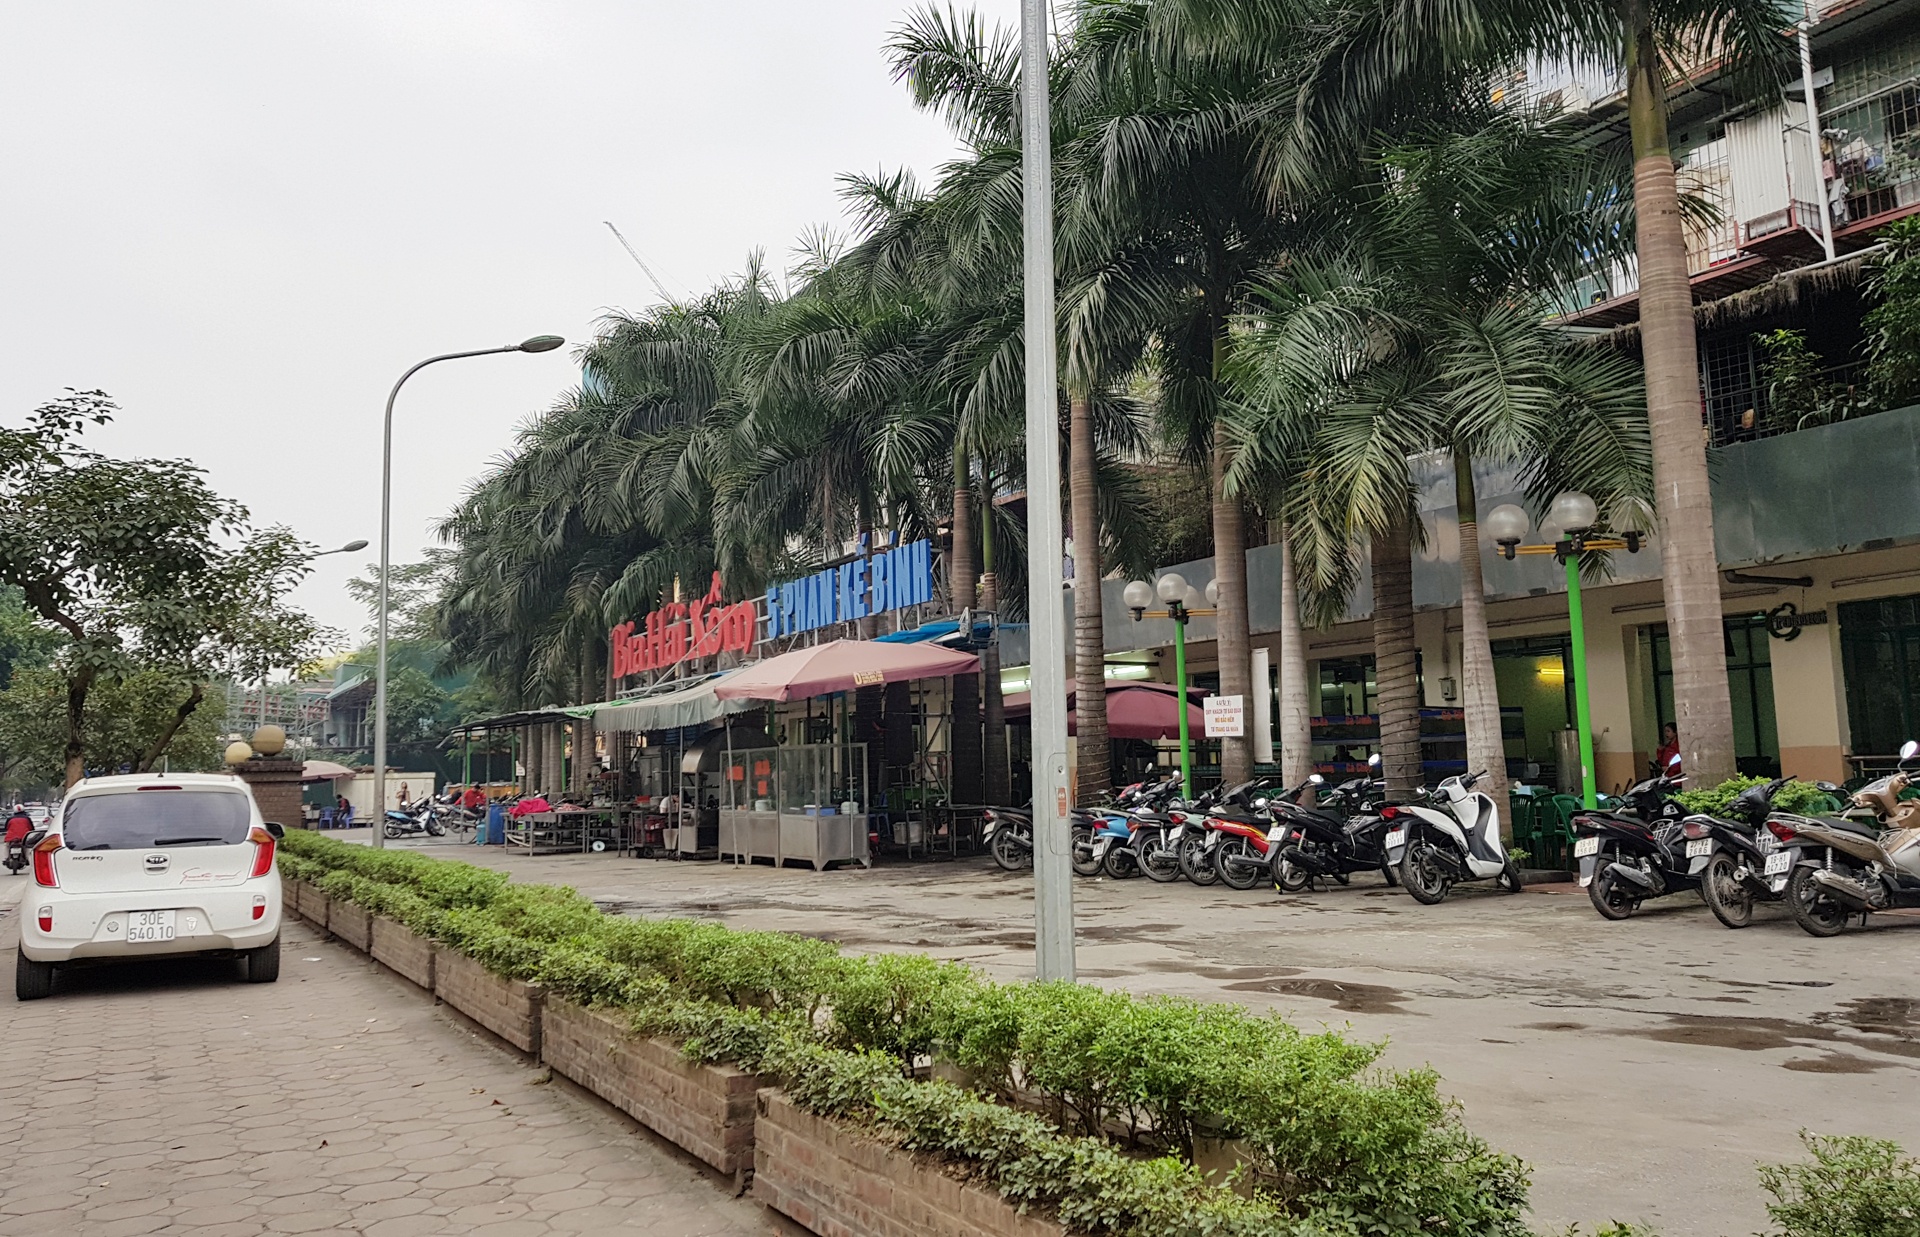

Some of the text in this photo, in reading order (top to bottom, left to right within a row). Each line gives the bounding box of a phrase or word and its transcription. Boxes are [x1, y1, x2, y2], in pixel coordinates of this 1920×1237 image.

[767, 587, 780, 640] 5
[783, 567, 837, 636] PHAN
[871, 530, 933, 614] BÍNH
[612, 620, 648, 679] Bia
[129, 926, 174, 941] 540.10
[139, 911, 165, 926] 30E
